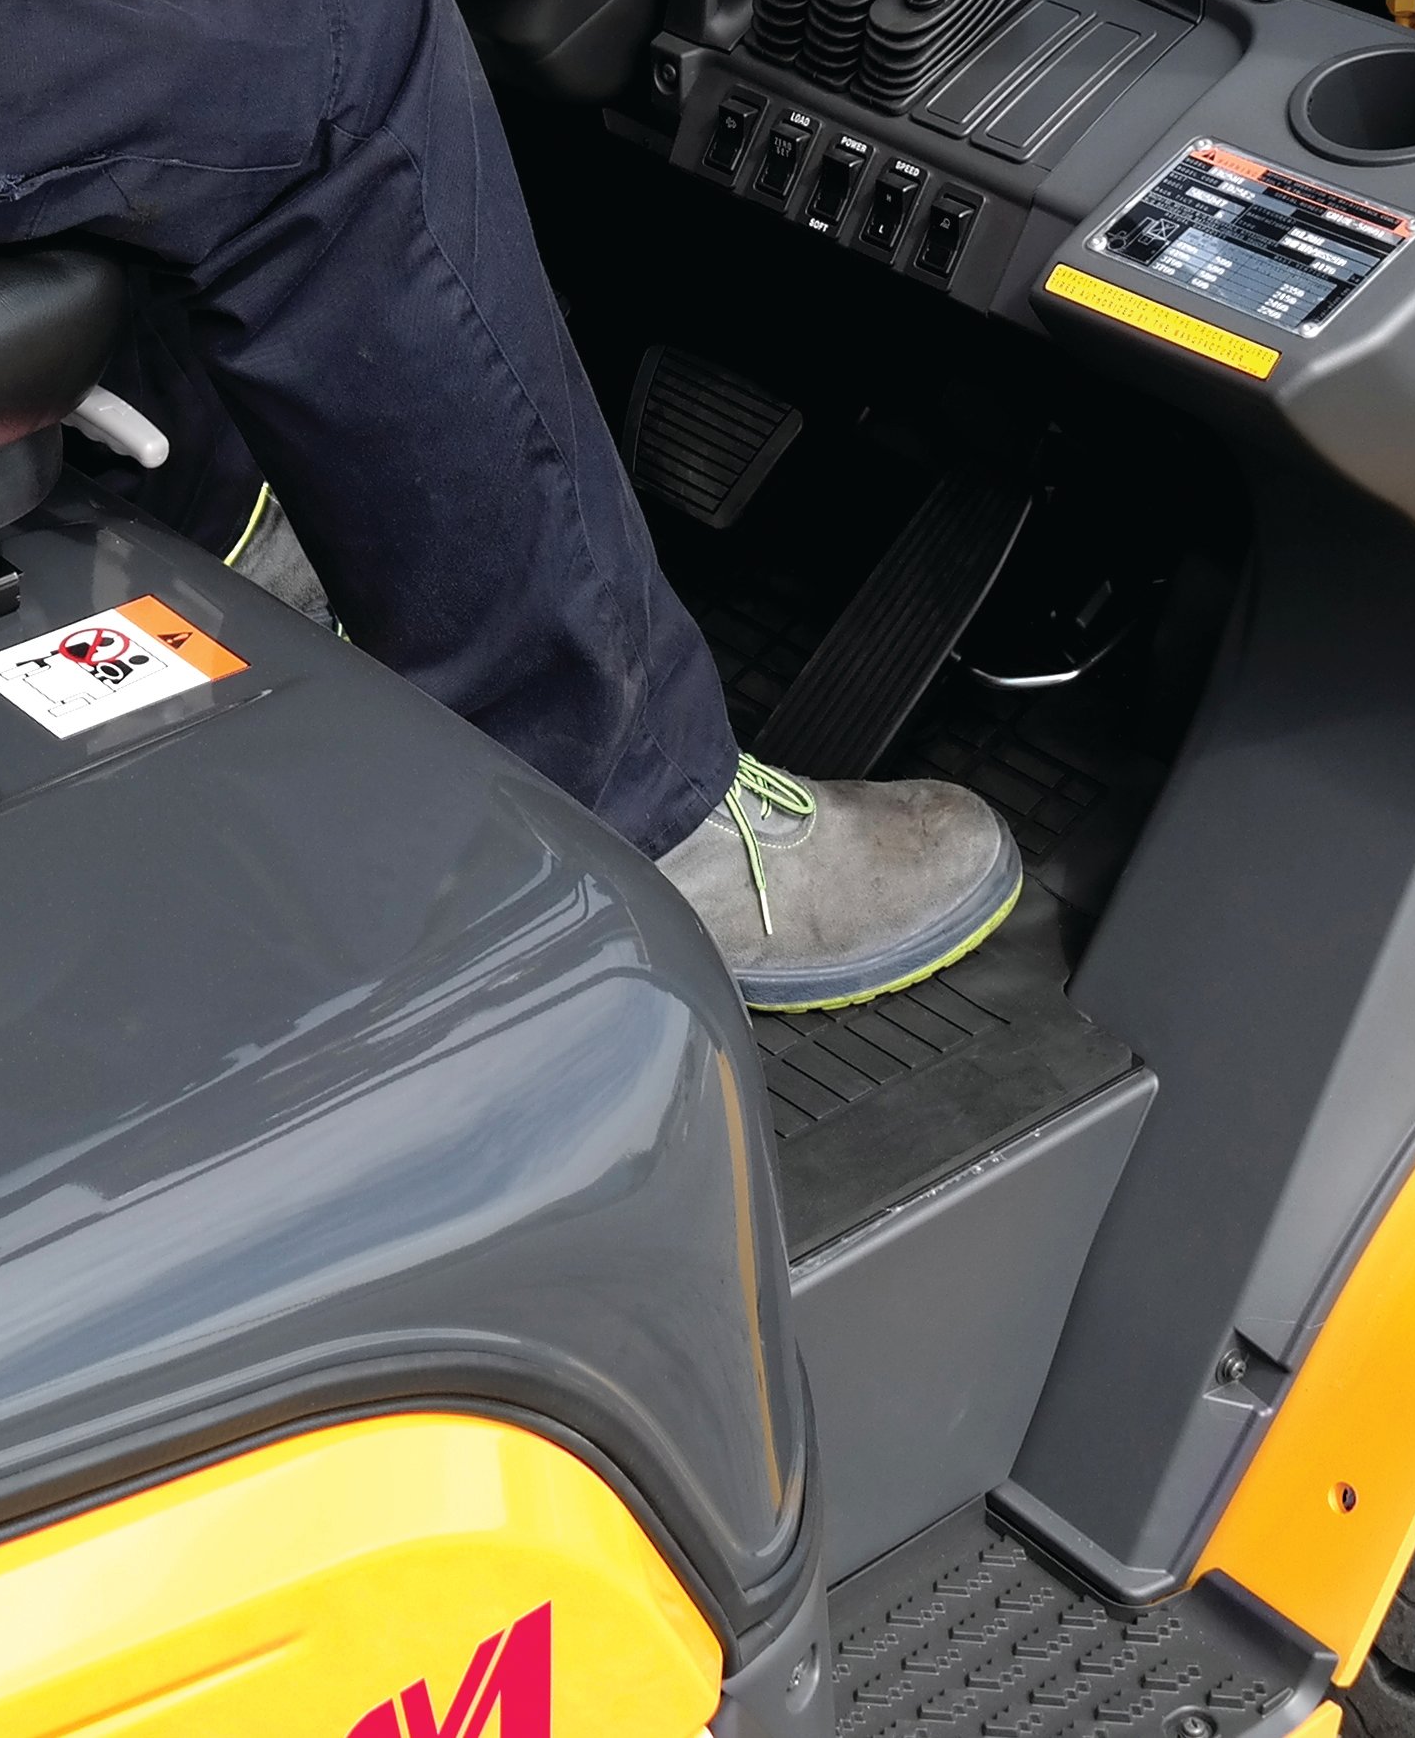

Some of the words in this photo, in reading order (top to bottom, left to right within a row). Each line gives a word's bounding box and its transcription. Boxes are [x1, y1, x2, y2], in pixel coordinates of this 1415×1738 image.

[790, 112, 811, 127] LOAD
[840, 136, 867, 153] POWER
[895, 160, 920, 177] SPEED
[808, 218, 829, 233] SOFT
